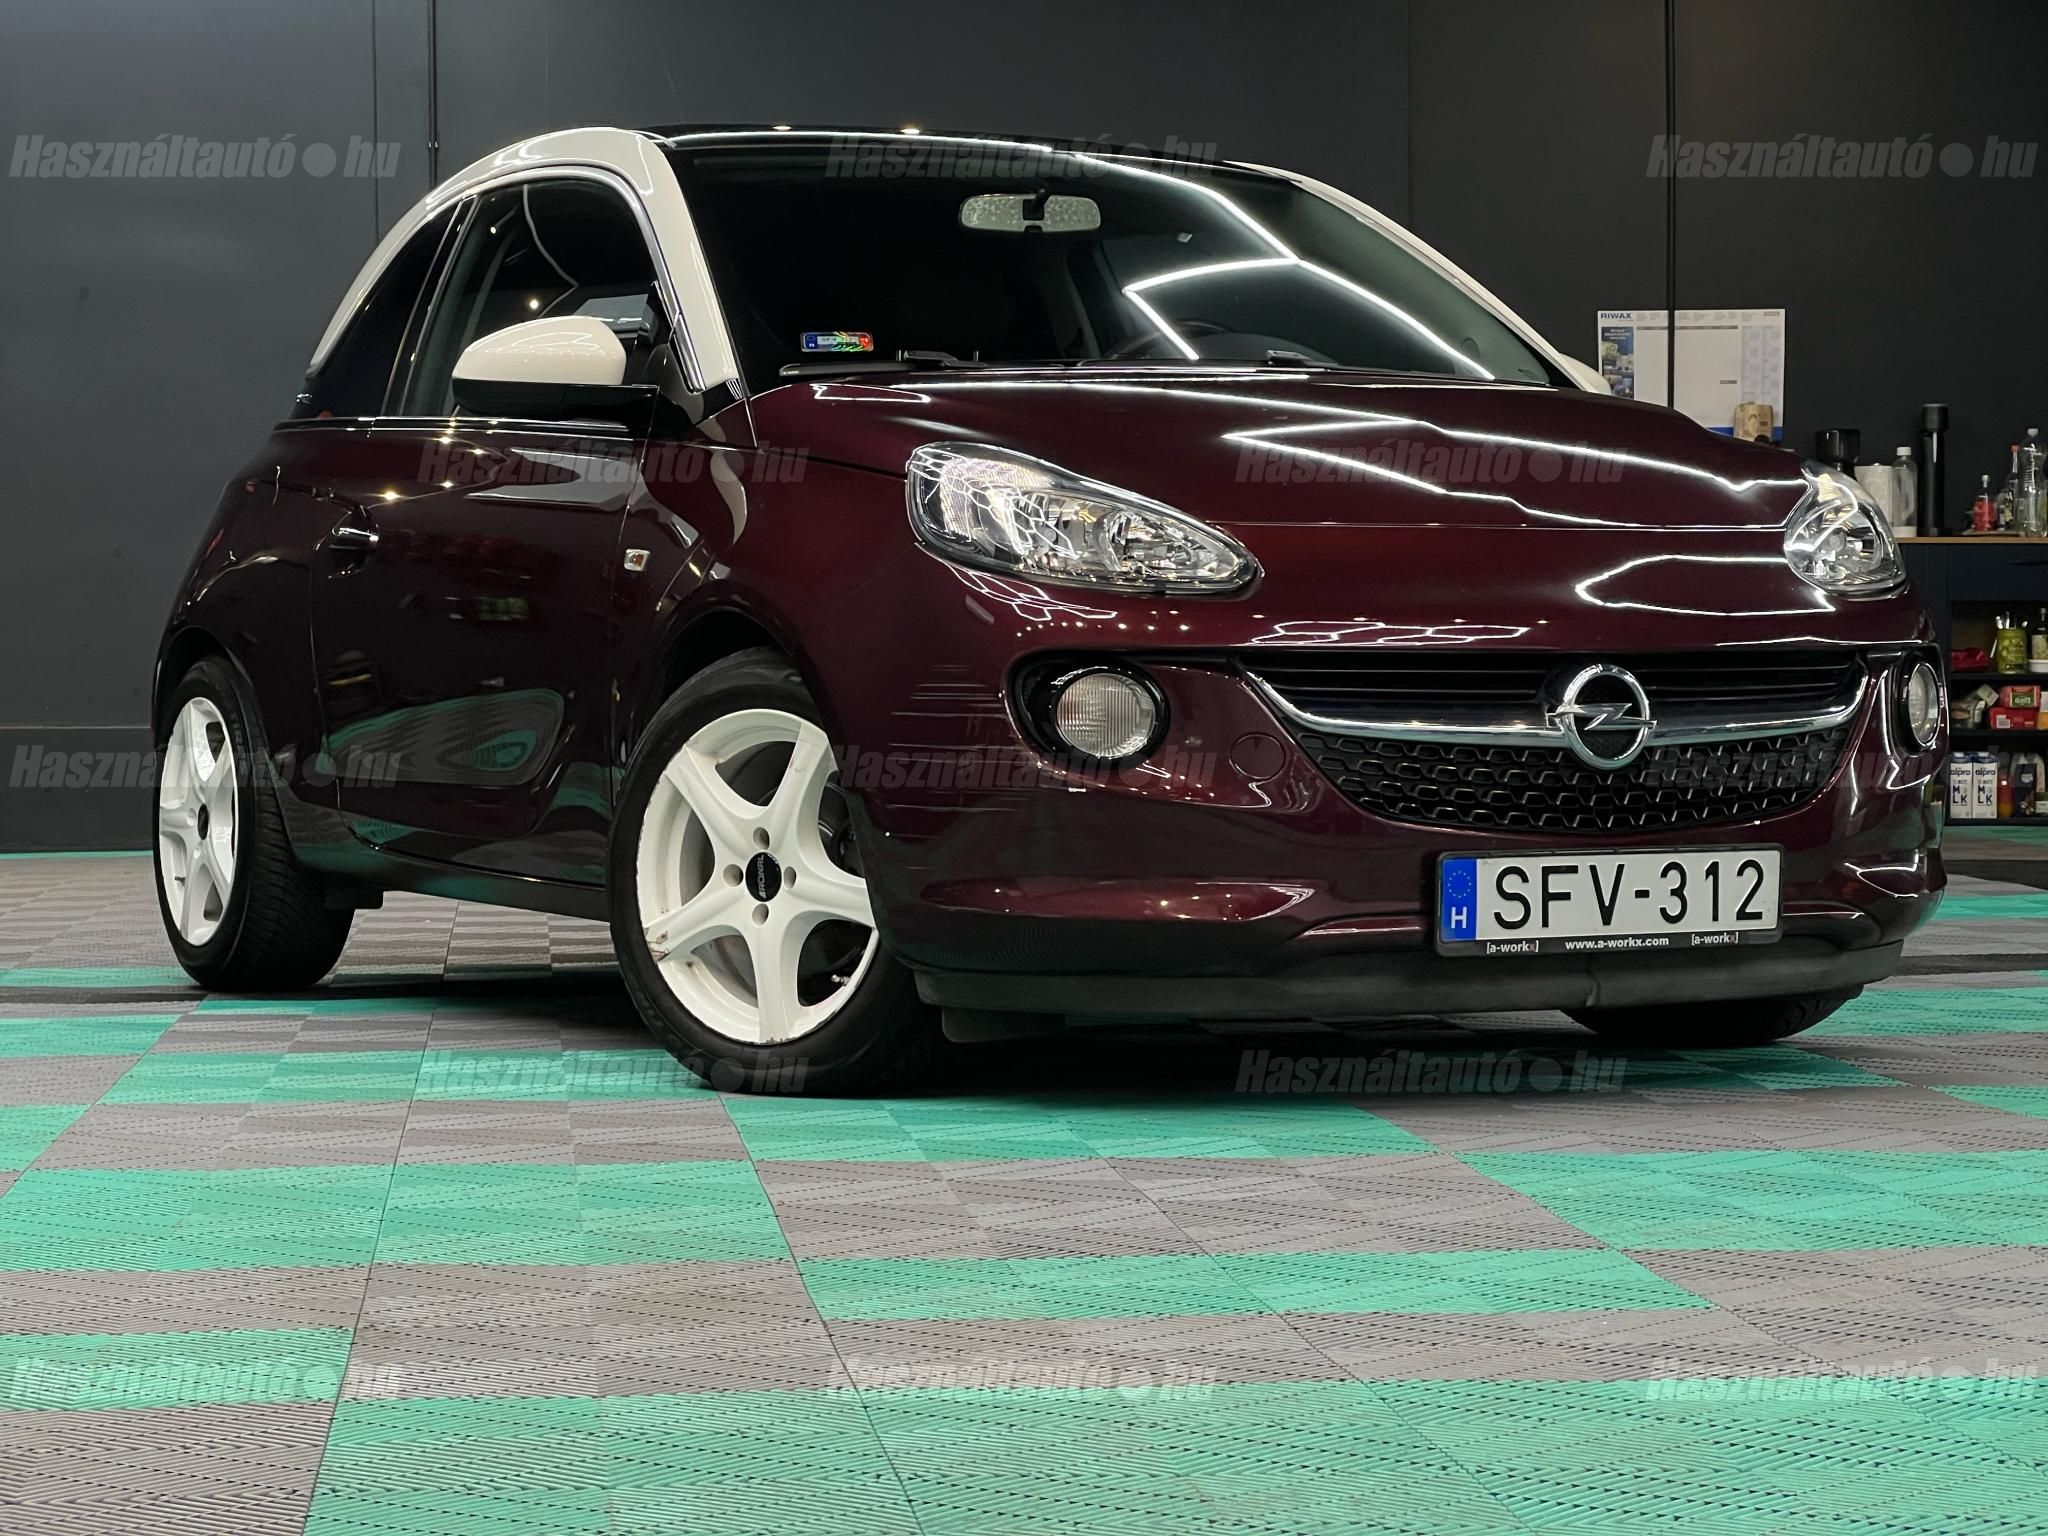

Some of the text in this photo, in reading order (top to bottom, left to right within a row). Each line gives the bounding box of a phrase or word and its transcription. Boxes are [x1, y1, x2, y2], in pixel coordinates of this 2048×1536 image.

[1975, 768, 1996, 777] alpro
[1493, 859, 1765, 931] SFV-312
[1450, 906, 1468, 930] H
[1565, 936, 1670, 951] www.a-workx.com
